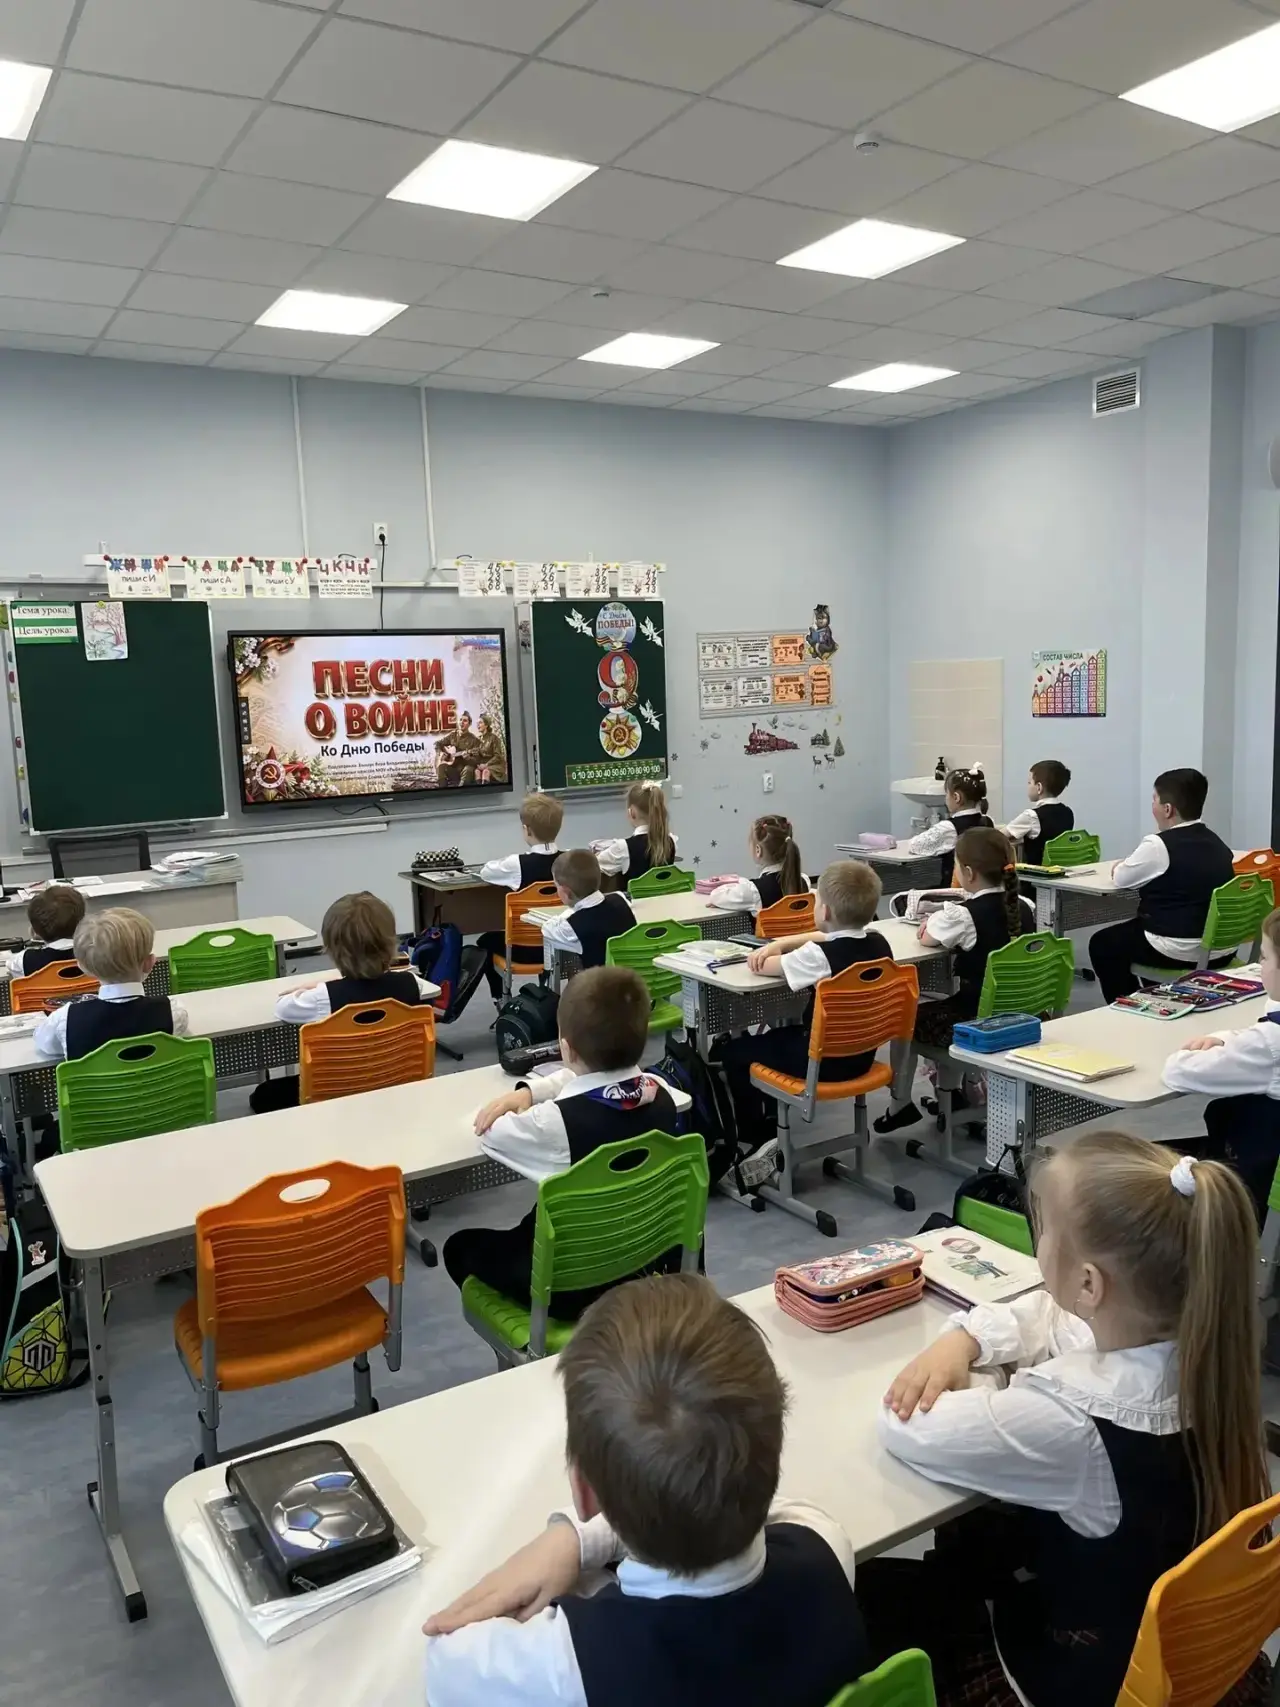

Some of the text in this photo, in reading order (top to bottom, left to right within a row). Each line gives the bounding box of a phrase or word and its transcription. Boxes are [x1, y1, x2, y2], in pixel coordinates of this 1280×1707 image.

[187, 559, 212, 574] ЧА
[18, 626, 72, 636] Цель урока:
[597, 618, 634, 629] ПОБЕДЫ!
[1042, 652, 1084, 661] СОСТАВ ЧИСЛА
[312, 658, 446, 698] ПЕСНИ
[304, 693, 458, 740] О ВОЙНЕ
[320, 741, 425, 758] Ко Дню Победы
[571, 771, 577, 780] 0
[577, 771, 586, 779] 10
[587, 770, 595, 779] 20
[595, 770, 603, 778] 30
[603, 769, 611, 777] 40
[612, 768, 619, 777] 50
[620, 767, 627, 776] 60
[627, 766, 635, 775] 70
[635, 766, 642, 775] 80
[643, 765, 650, 774] 90
[651, 764, 661, 773] 100
